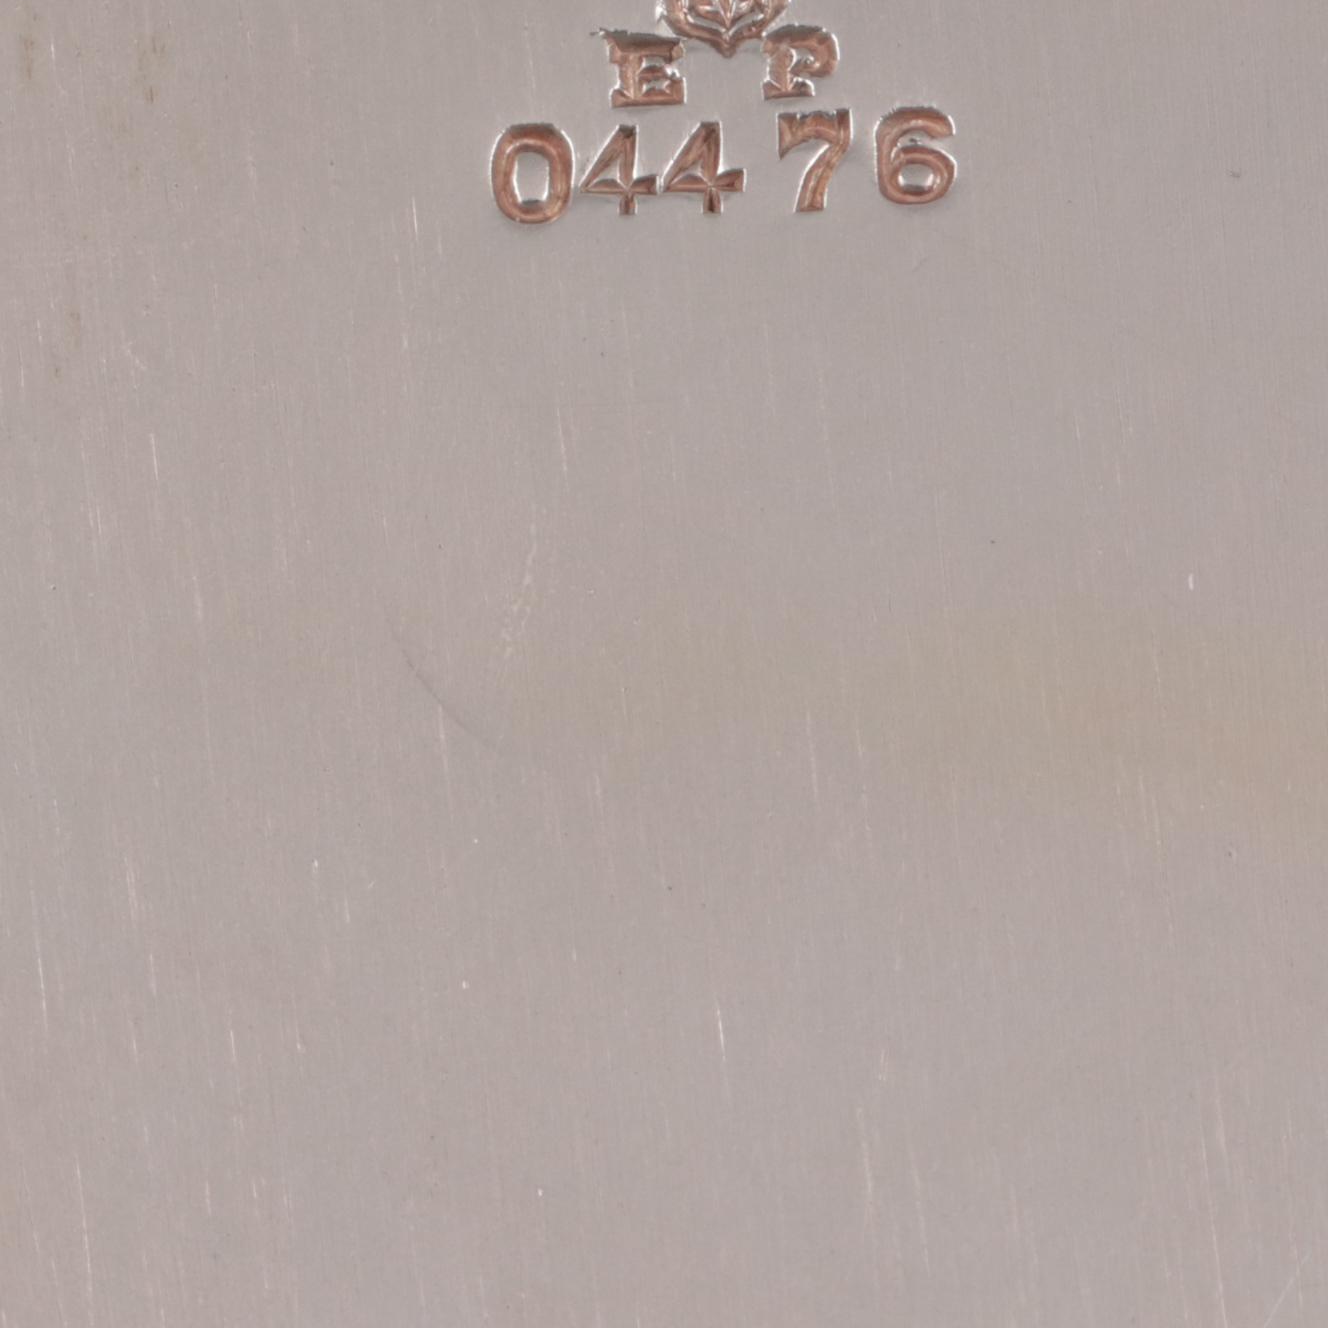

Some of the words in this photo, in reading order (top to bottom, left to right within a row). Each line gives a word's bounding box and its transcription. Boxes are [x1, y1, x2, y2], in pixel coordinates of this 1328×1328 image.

[604, 28, 686, 108] E
[762, 24, 840, 102] P
[489, 106, 958, 224] 04476
